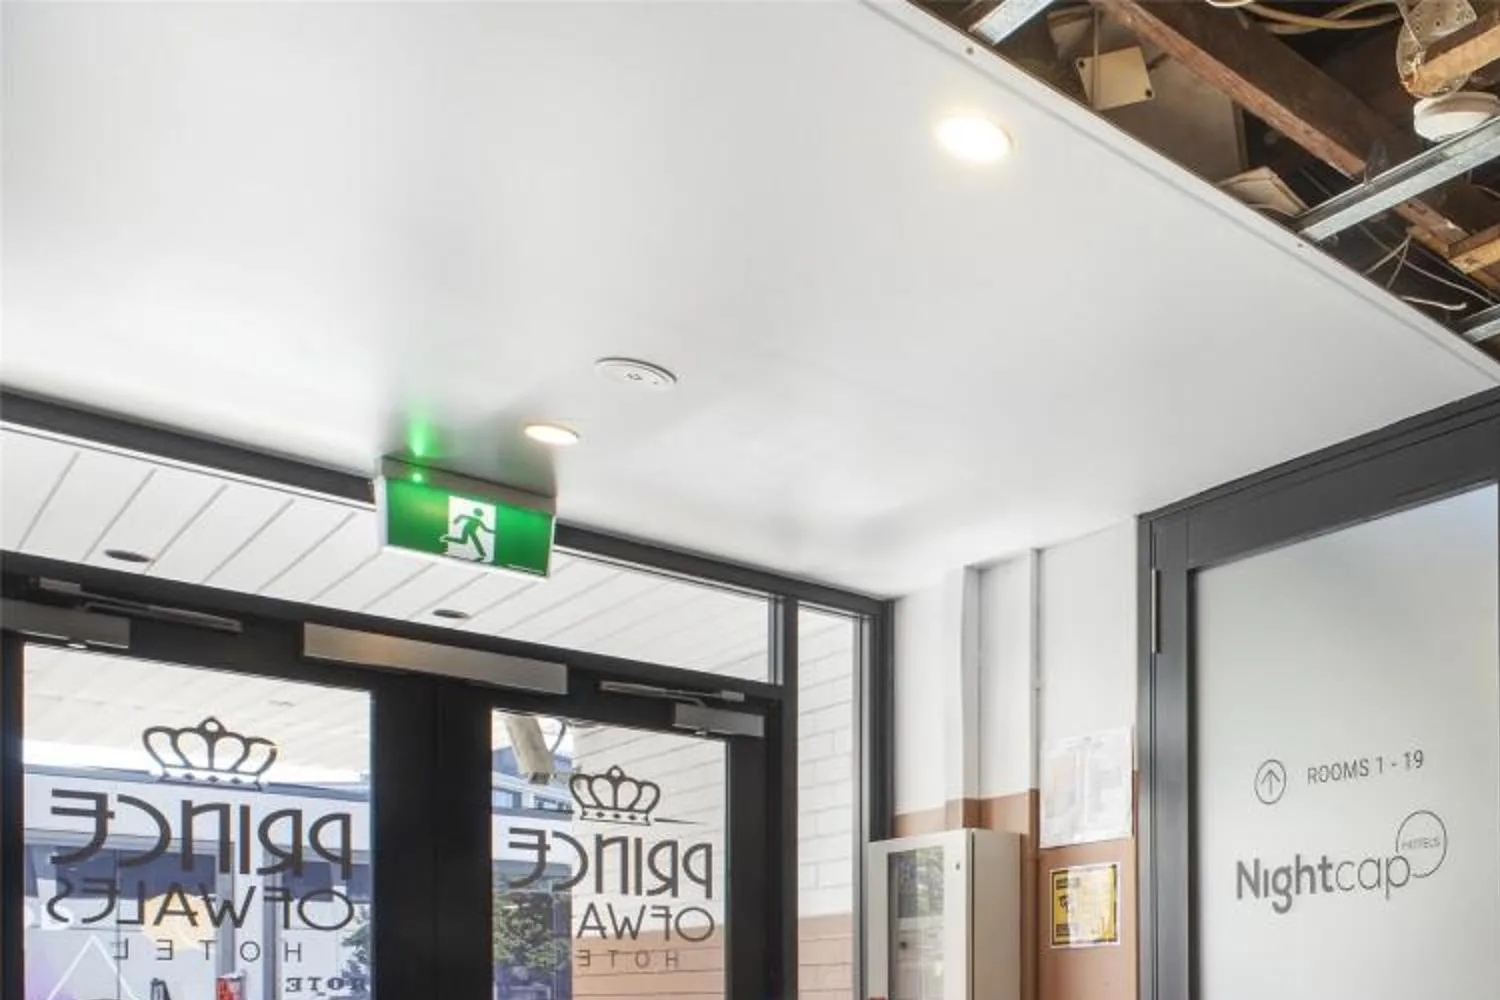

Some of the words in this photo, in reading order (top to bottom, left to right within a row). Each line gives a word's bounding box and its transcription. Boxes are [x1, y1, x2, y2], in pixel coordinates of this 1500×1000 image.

[1307, 758, 1369, 785] ROOMS
[1375, 756, 1383, 775] 1
[1403, 749, 1424, 771] 19
[1236, 853, 1411, 914] Nightcap
